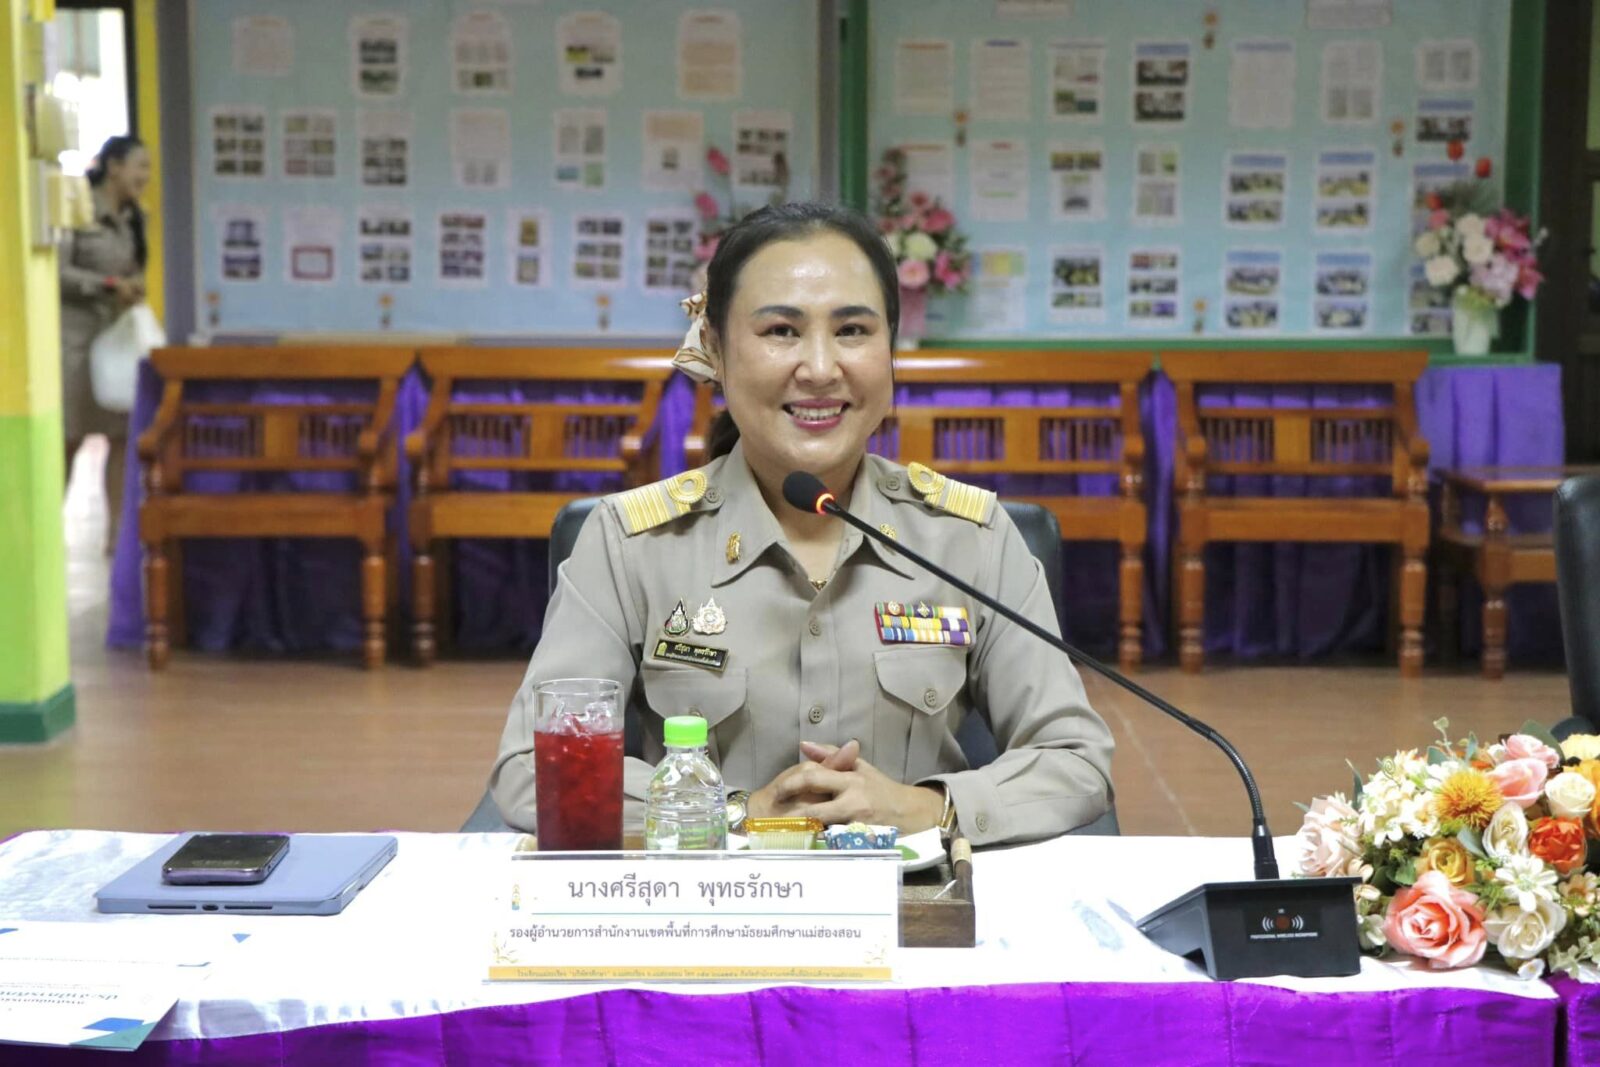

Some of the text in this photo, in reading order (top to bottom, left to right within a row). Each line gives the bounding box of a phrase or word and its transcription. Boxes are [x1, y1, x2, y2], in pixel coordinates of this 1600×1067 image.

[568, 872, 803, 907] นางศรีสุดา พุทธรักษา
